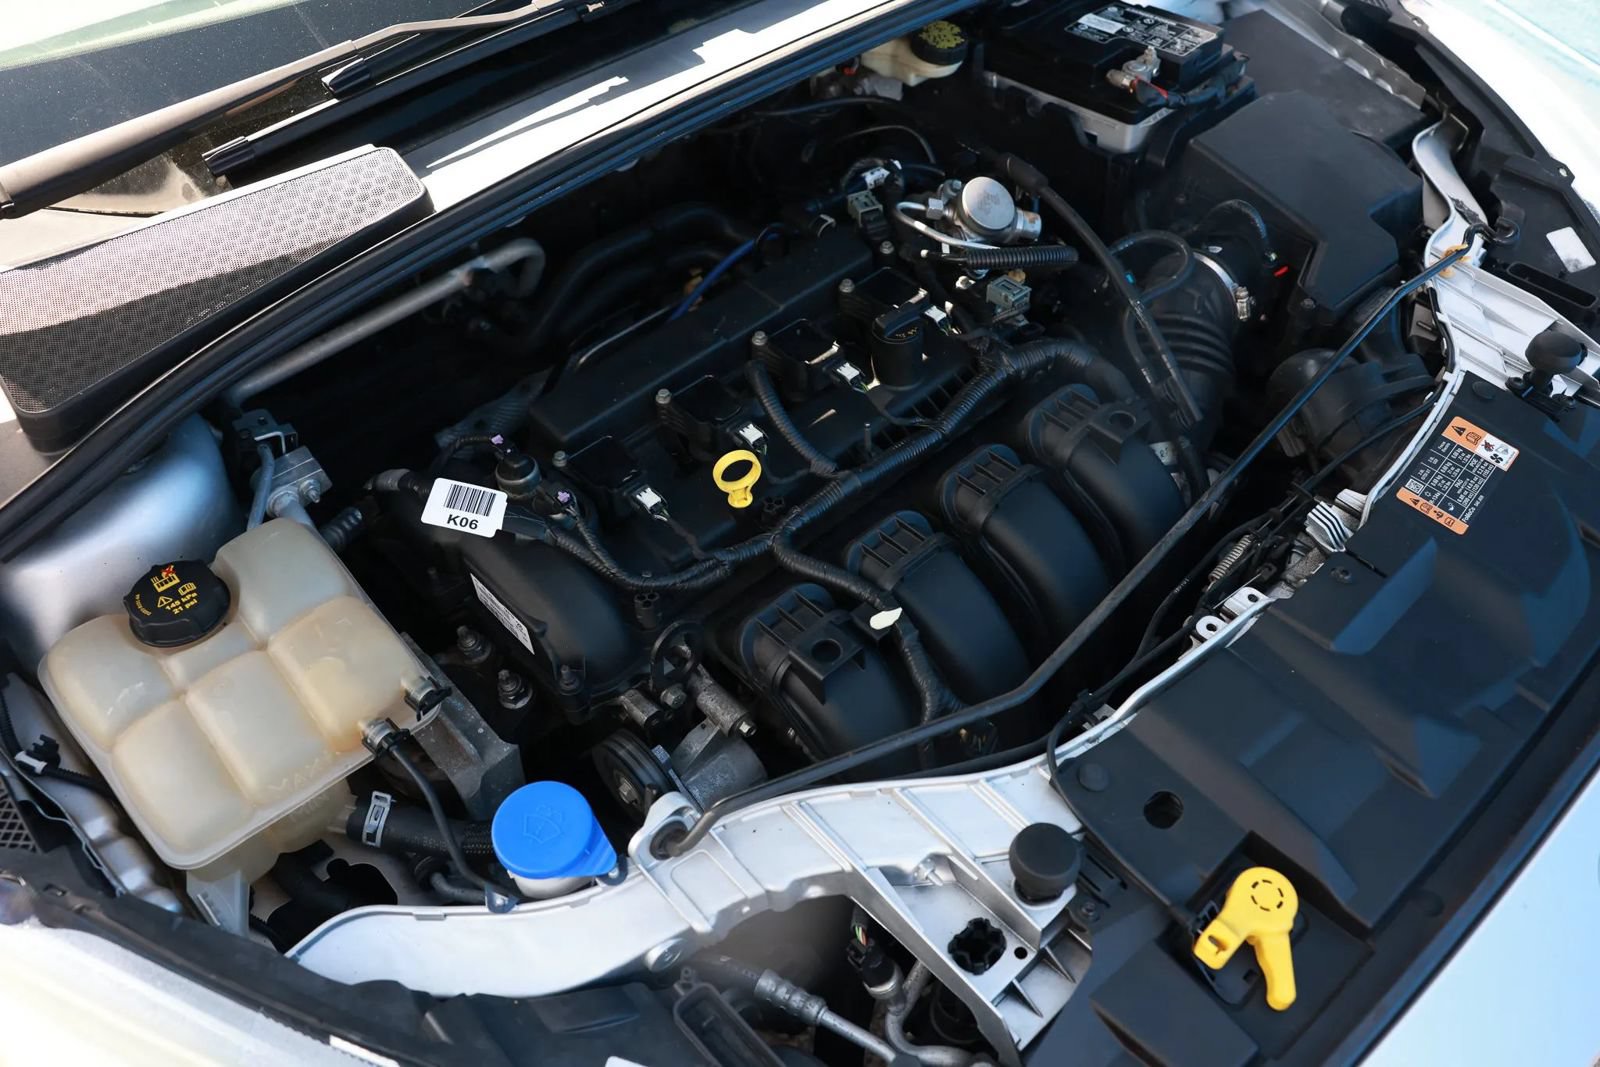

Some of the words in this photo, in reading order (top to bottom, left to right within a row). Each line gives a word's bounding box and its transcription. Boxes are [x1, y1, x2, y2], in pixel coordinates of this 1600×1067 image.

[447, 514, 479, 530] K06
[1462, 506, 1476, 523] FoMoCo
[165, 600, 180, 610] 145
[181, 592, 197, 602] kPa
[172, 606, 183, 614] 21
